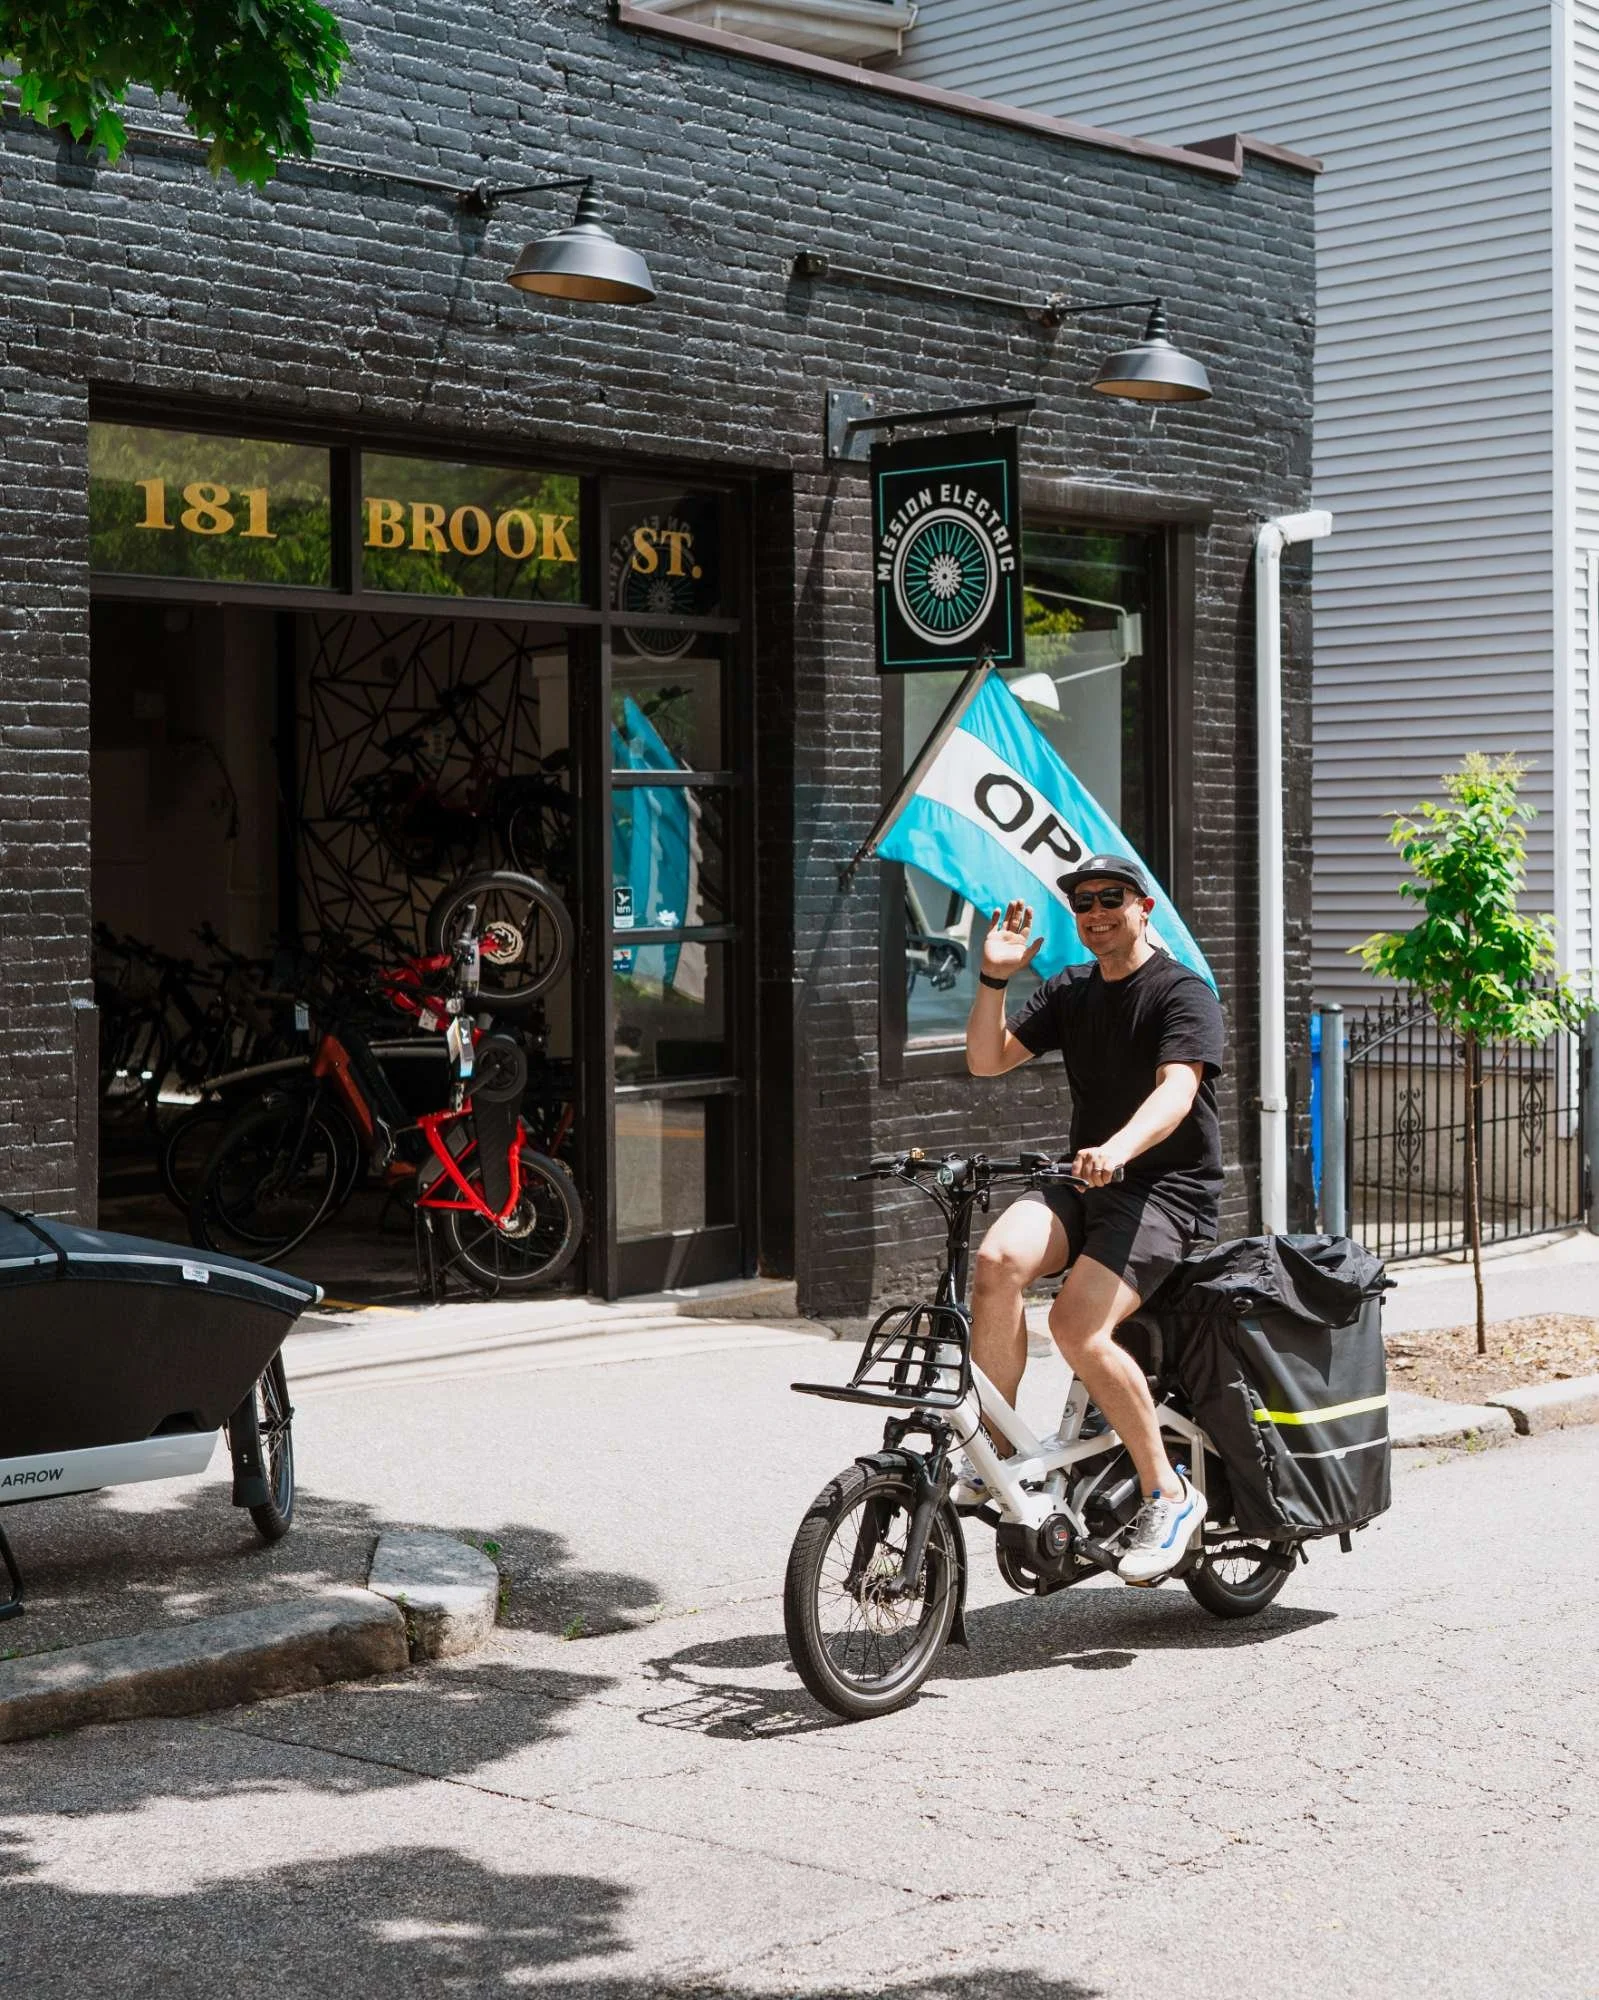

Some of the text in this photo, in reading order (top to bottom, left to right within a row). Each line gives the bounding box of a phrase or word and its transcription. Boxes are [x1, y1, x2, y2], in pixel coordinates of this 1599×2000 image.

[135, 478, 703, 579] 181 BROOK ST.
[877, 484, 1015, 581] MISSION ELECTRIC
[1, 1468, 64, 1488] ARROW
